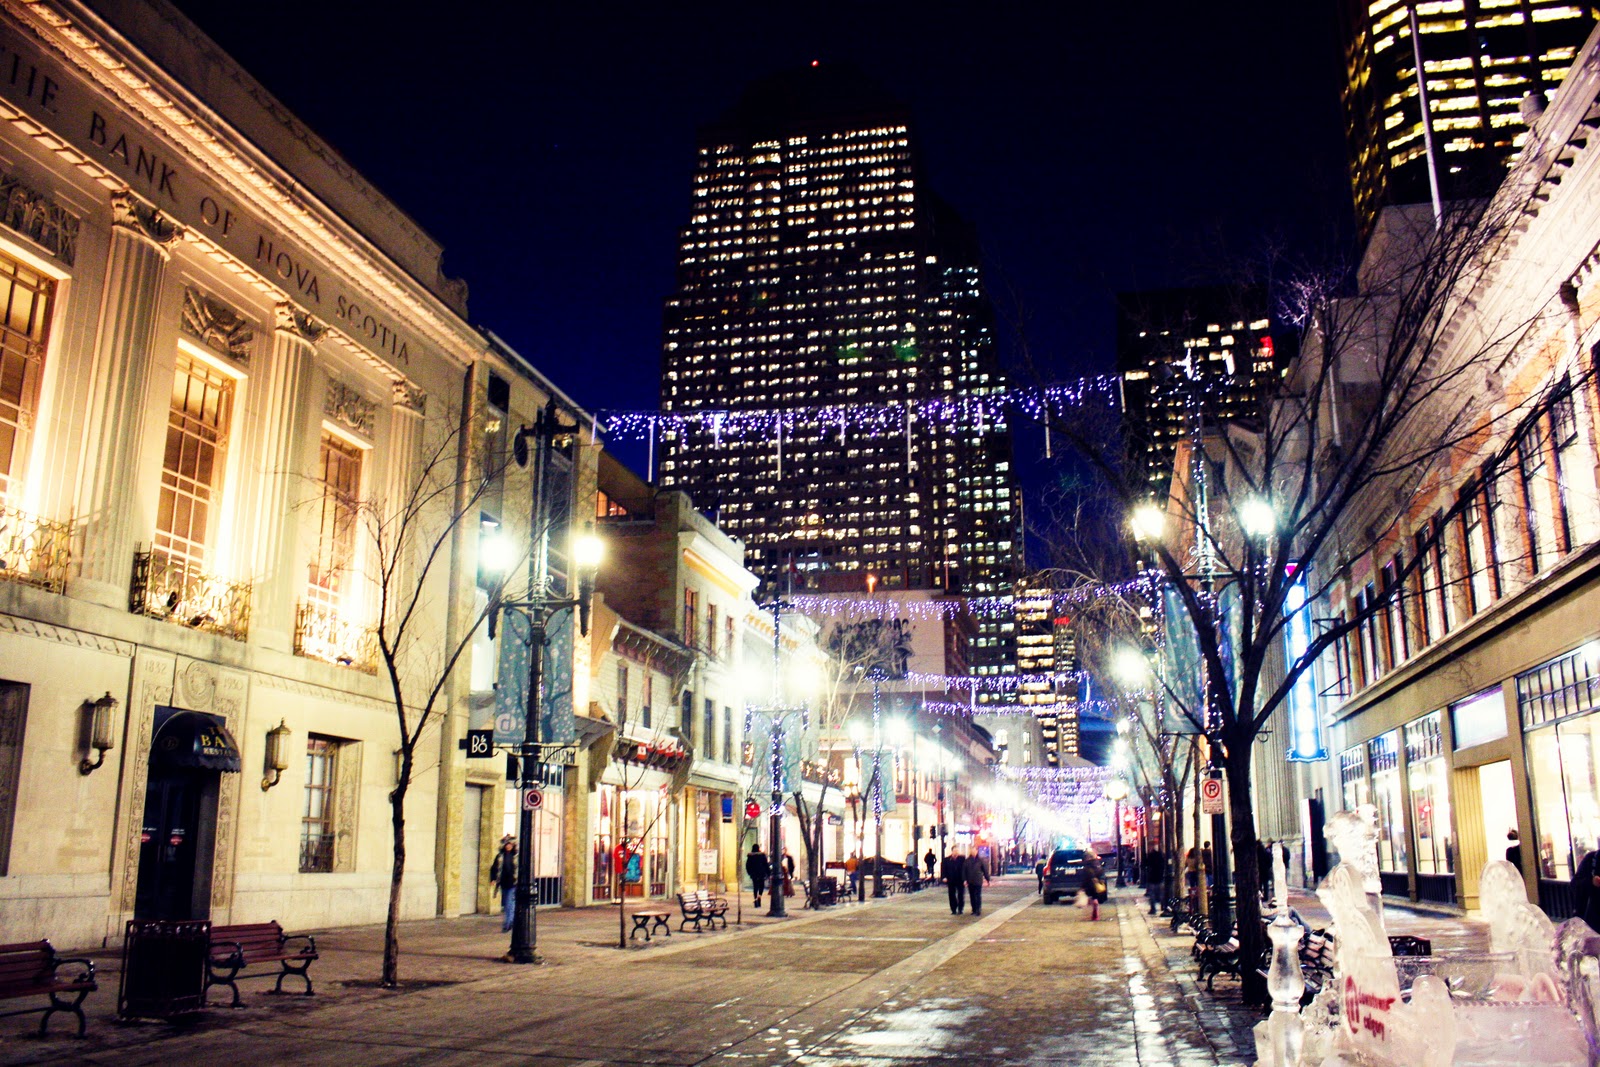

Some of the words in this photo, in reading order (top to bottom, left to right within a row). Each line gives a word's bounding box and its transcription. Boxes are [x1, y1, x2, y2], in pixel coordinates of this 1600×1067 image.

[88, 111, 179, 201] BANK
[199, 195, 238, 238] OF
[257, 235, 321, 304] NOVA
[336, 294, 410, 365] SCOTIA
